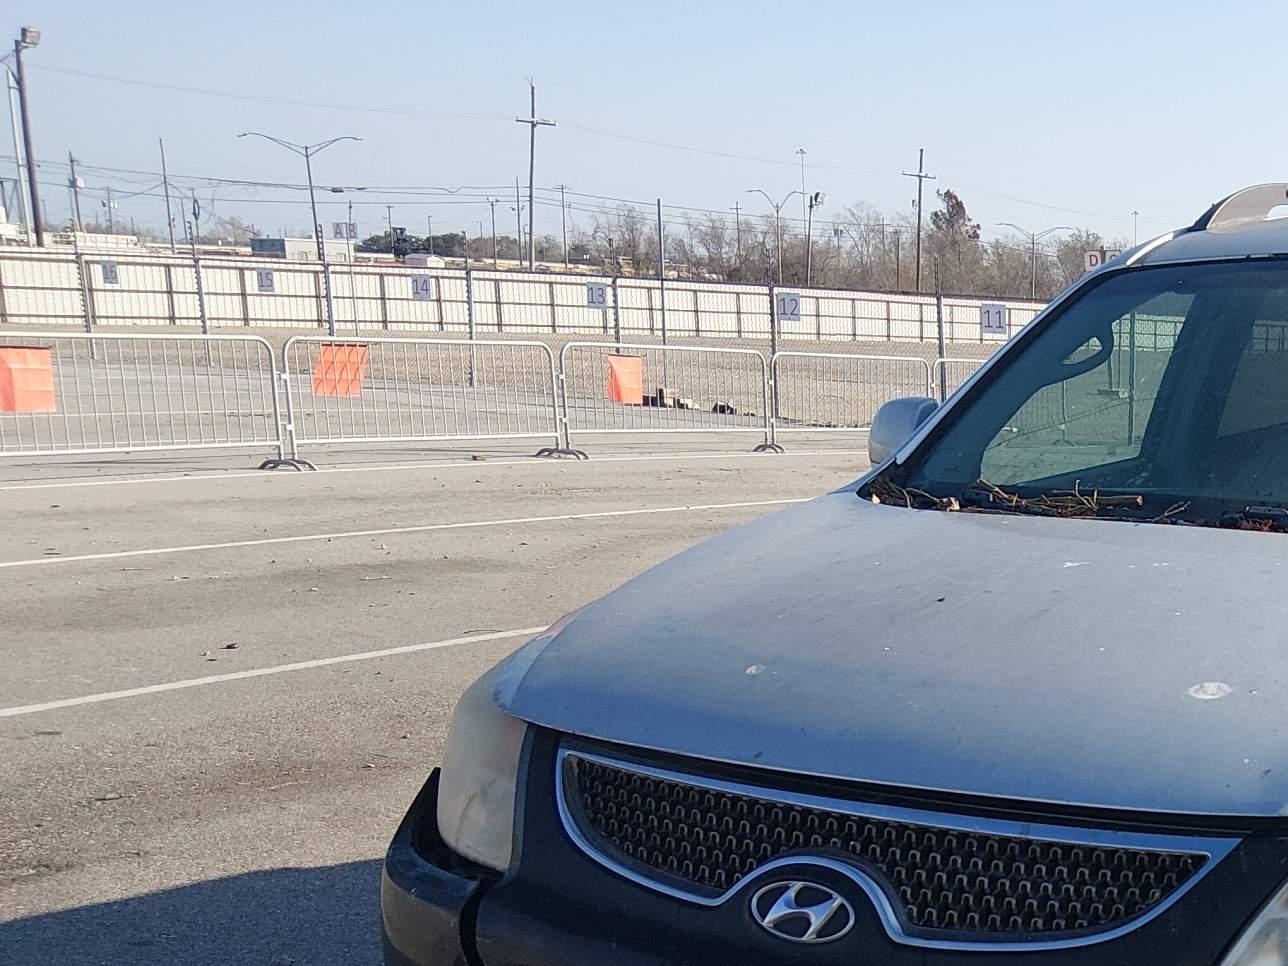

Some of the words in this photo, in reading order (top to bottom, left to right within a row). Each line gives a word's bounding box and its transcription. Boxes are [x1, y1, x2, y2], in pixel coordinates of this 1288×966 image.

[333, 223, 343, 238] A
[348, 223, 357, 239] B
[1089, 254, 1099, 267] D
[102, 264, 118, 281] 16
[258, 272, 274, 288] 15
[412, 278, 429, 297] 14
[587, 285, 606, 305] 13
[778, 297, 799, 318] 12
[984, 308, 1005, 329] 11
